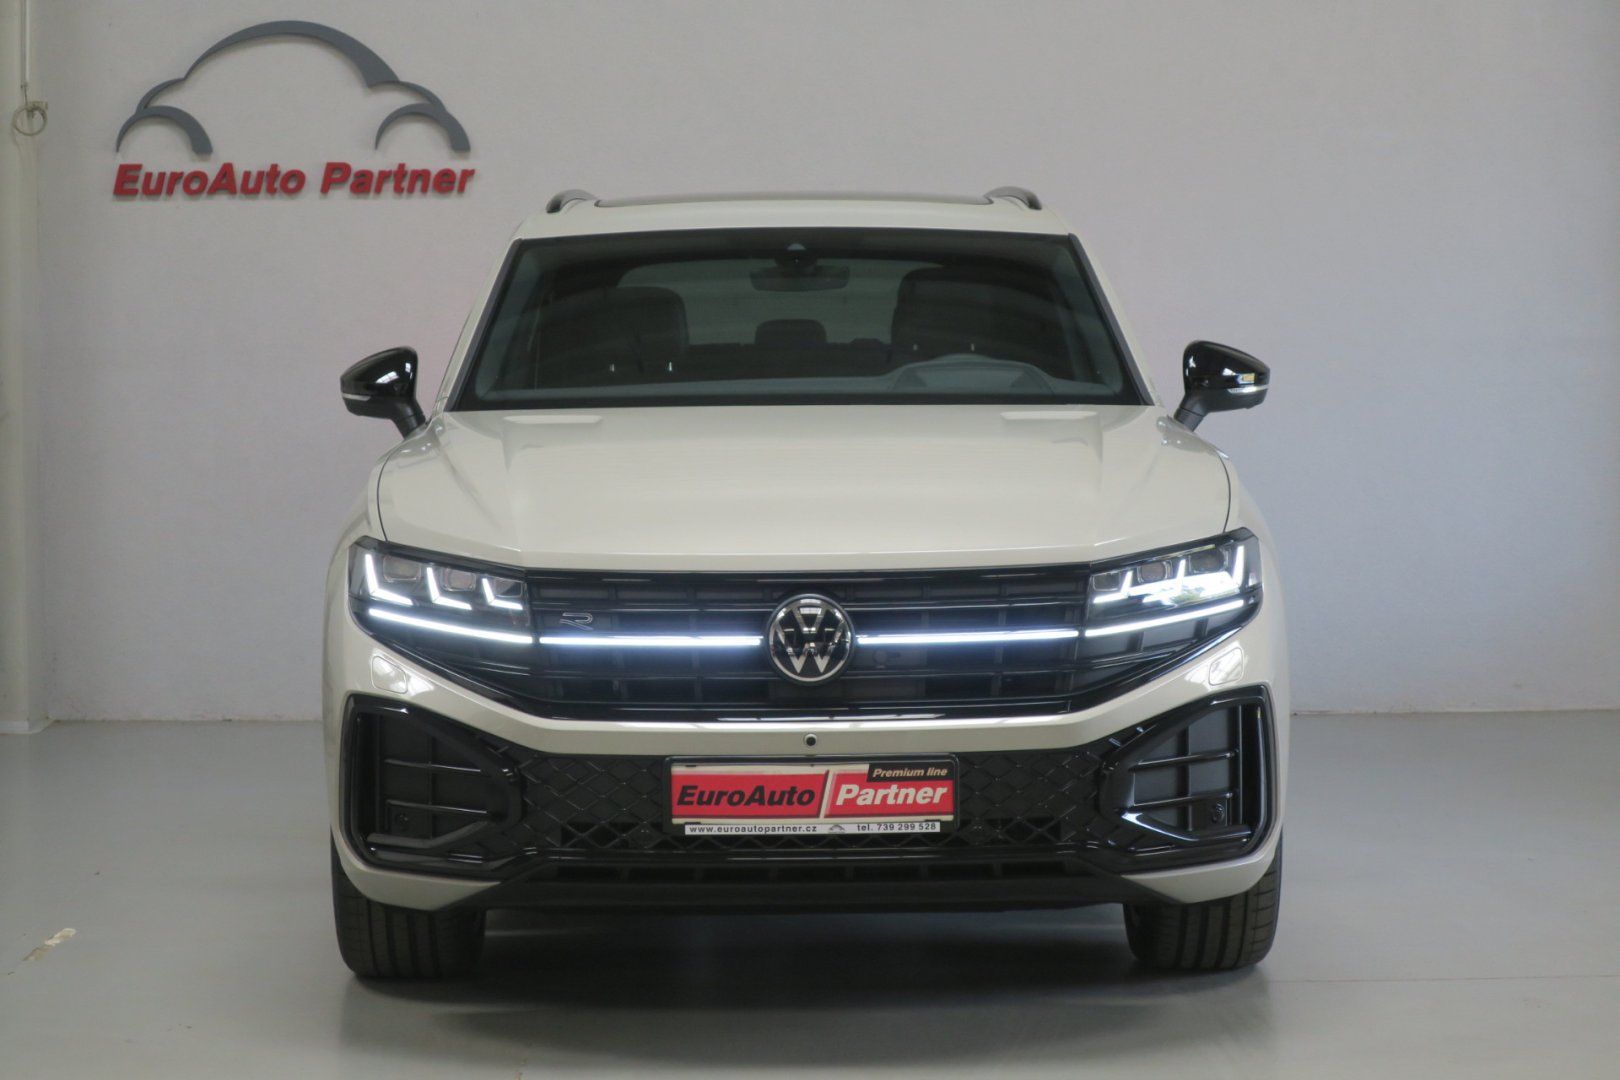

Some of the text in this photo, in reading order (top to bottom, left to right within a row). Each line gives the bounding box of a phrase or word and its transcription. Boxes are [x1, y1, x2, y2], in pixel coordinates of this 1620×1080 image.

[113, 161, 476, 196] EuroAuto Partner
[872, 767, 948, 778] Premium line
[677, 783, 948, 806] EuroAuto Partner
[689, 822, 937, 834] www.euroautopartner.cz tel. 739 299 528
